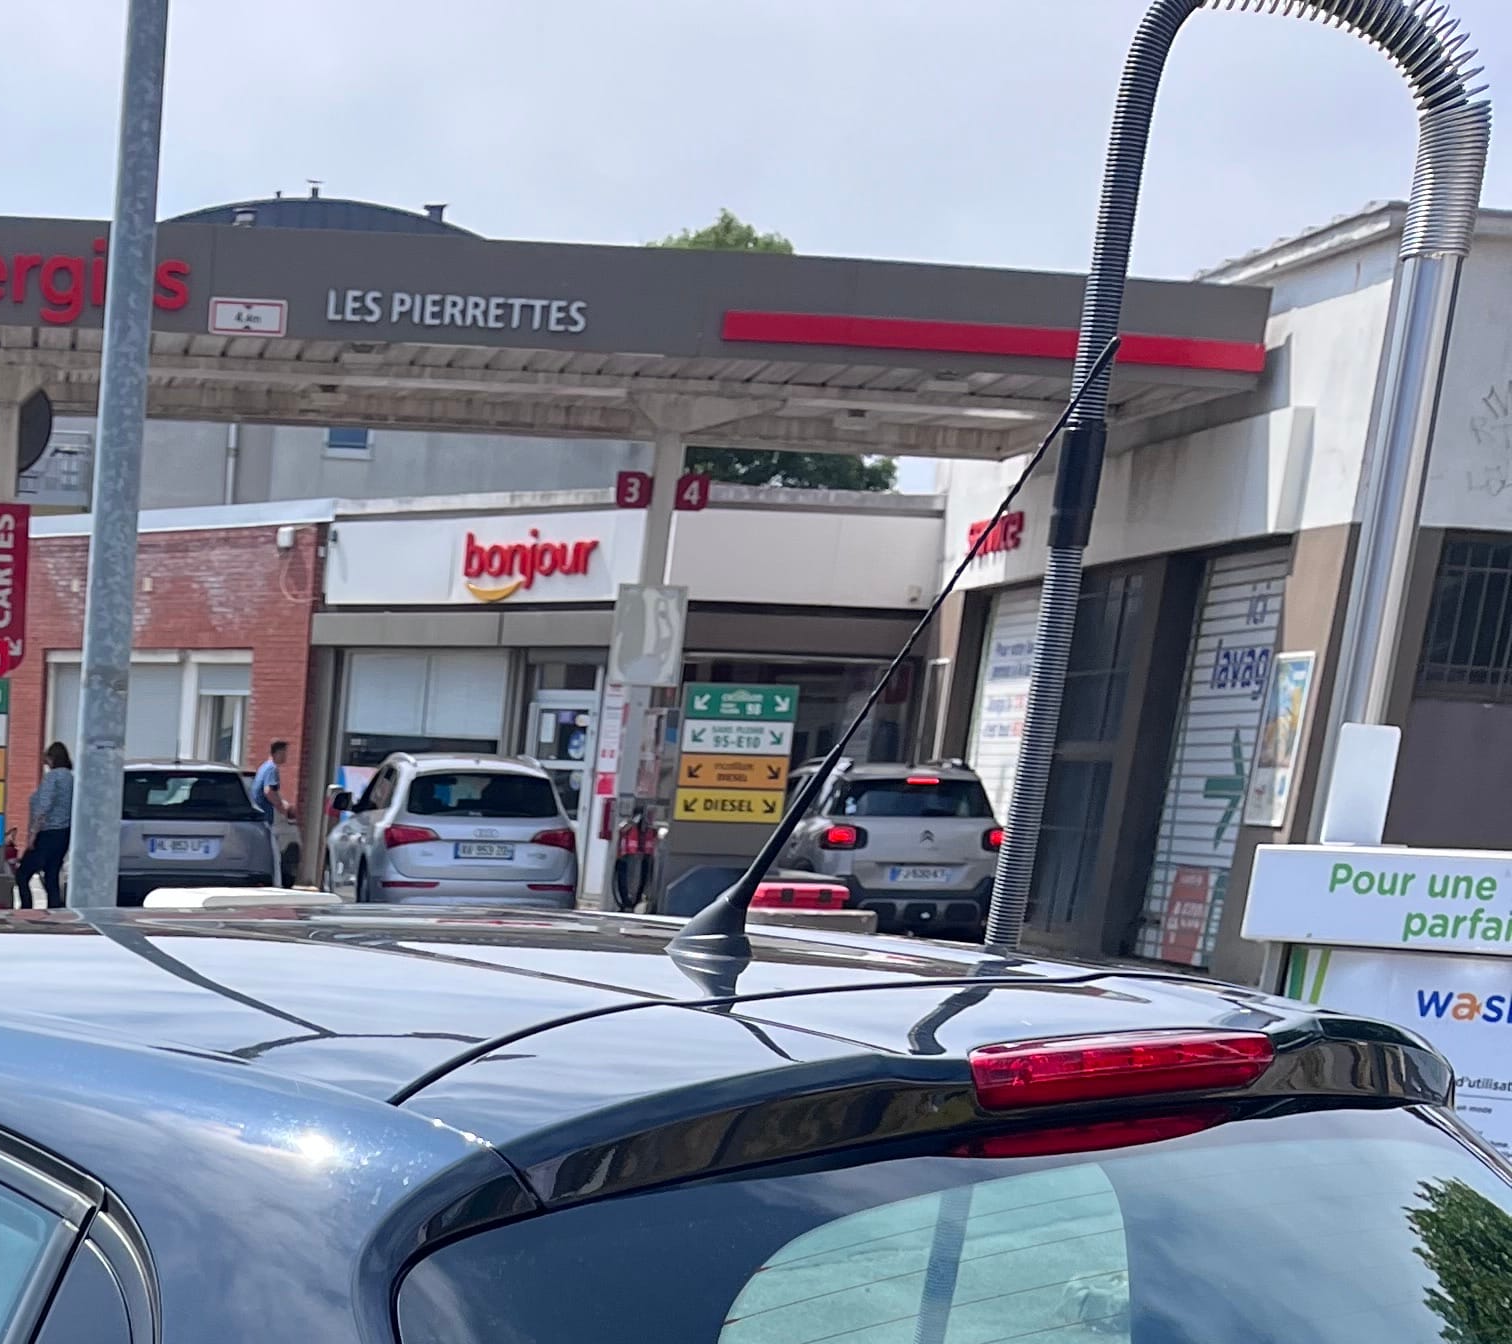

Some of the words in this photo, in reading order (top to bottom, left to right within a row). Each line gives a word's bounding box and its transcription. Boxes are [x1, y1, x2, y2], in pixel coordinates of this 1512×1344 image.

[327, 288, 383, 323] LES
[390, 291, 587, 333] PIERRETTES
[624, 478, 641, 503] 3
[684, 481, 701, 505] 4
[464, 528, 600, 590] bonjour
[703, 799, 753, 813] DIESEL
[1329, 863, 1416, 897] Pour
[1428, 874, 1498, 901] une
